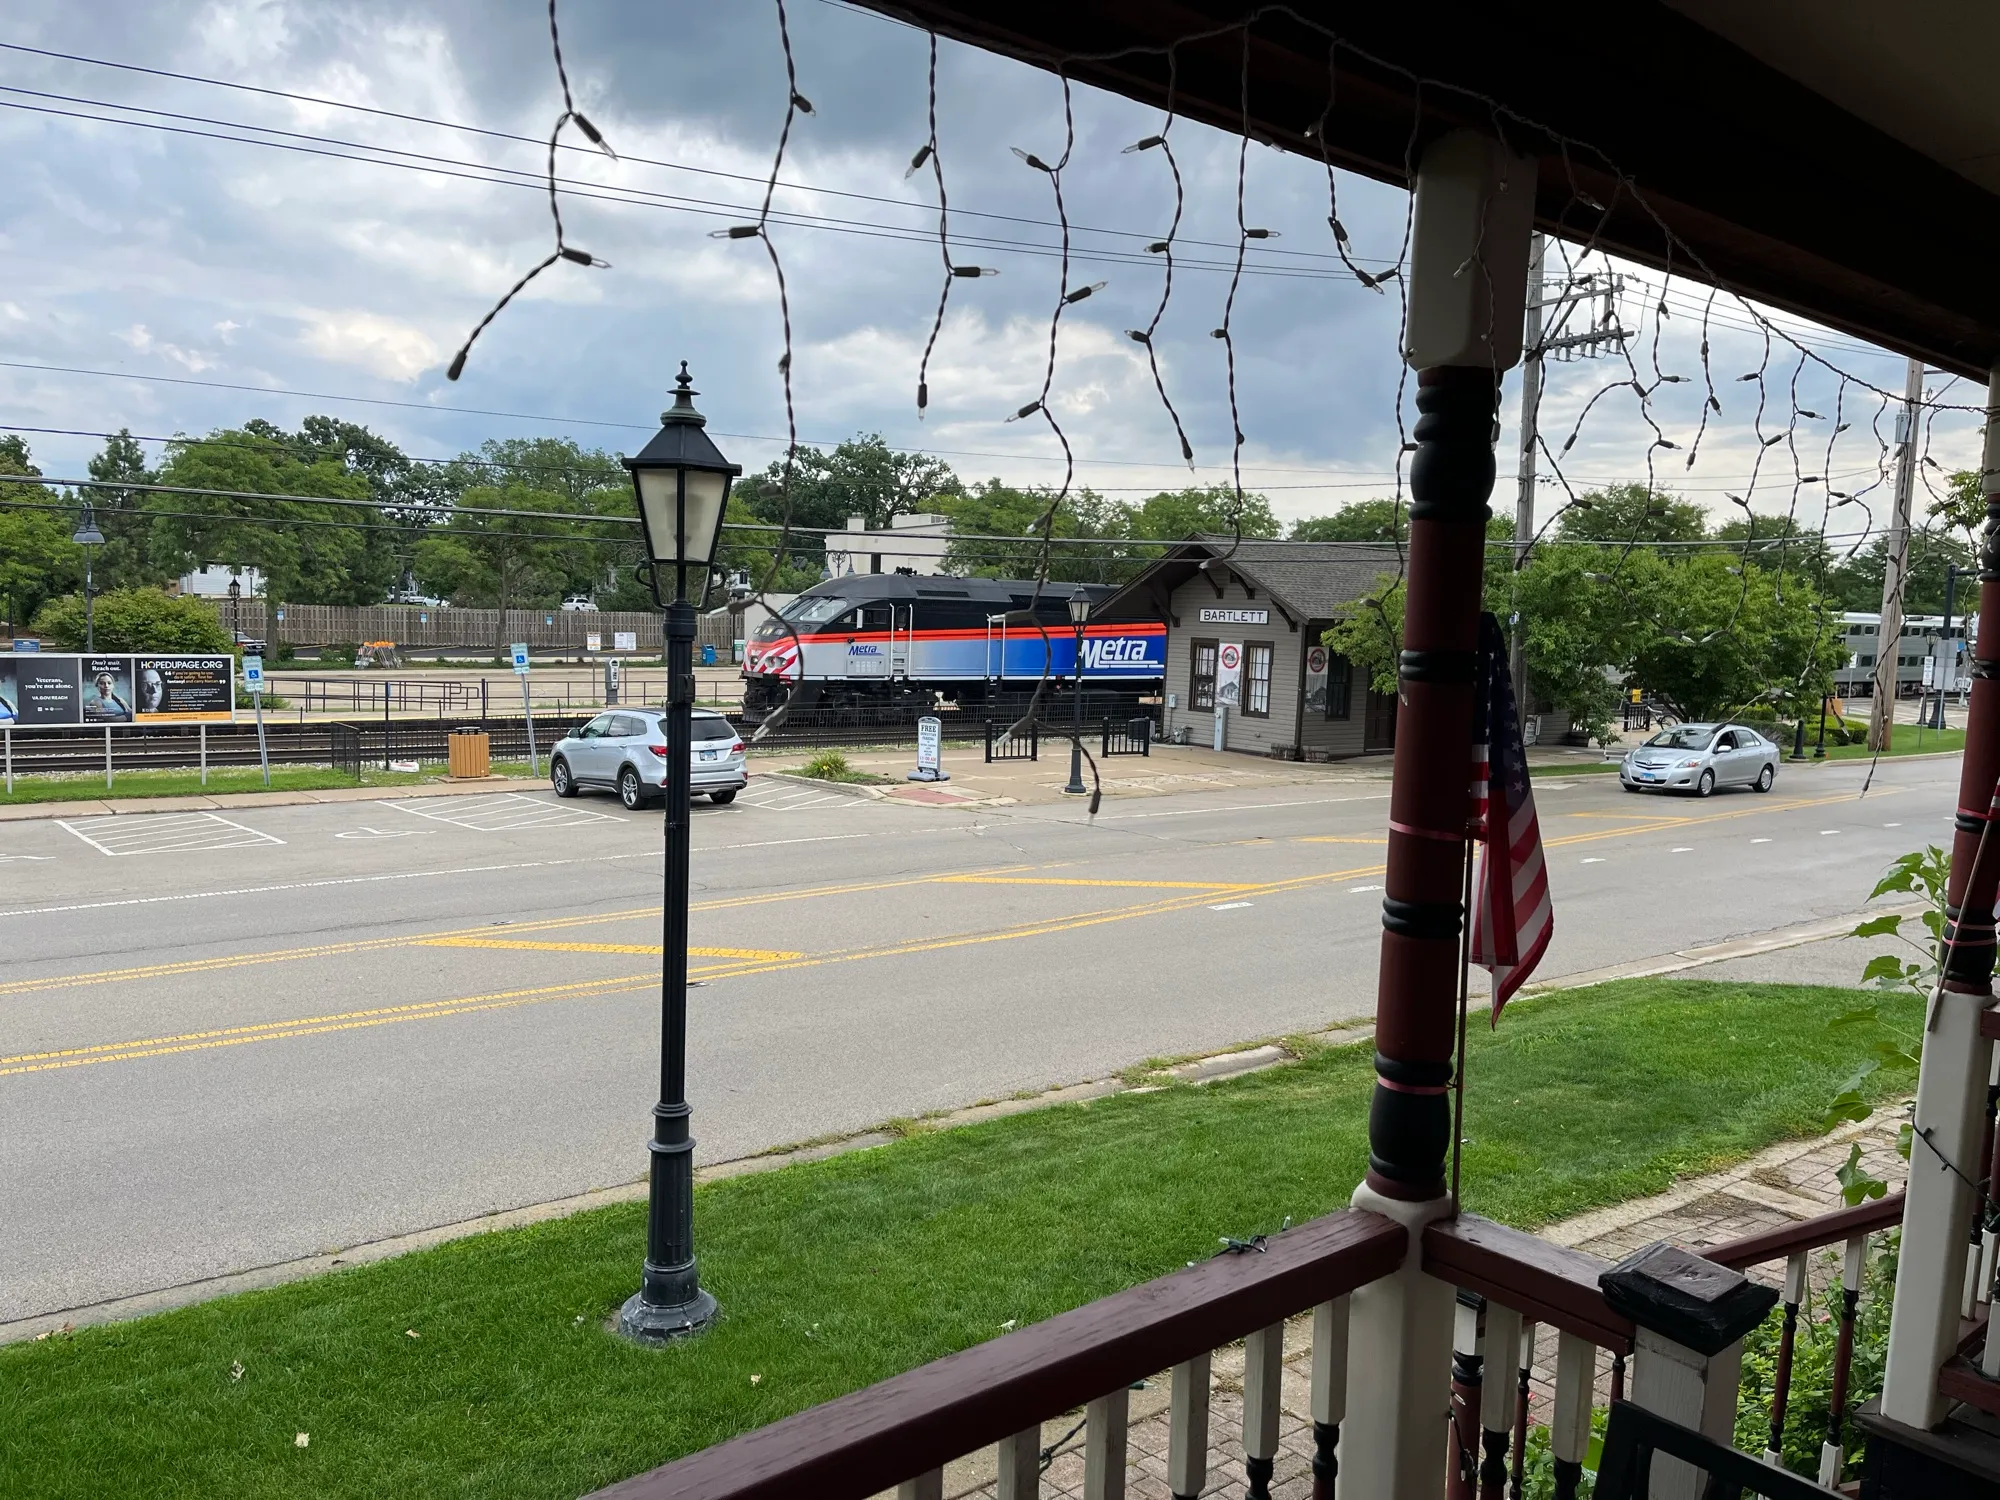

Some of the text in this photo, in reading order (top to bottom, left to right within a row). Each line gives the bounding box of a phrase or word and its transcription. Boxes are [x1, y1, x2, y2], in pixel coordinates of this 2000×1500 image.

[848, 645, 877, 655] Metra
[1074, 637, 1147, 668] Metra
[141, 661, 223, 669] HOPEDUPAGE.ORG
